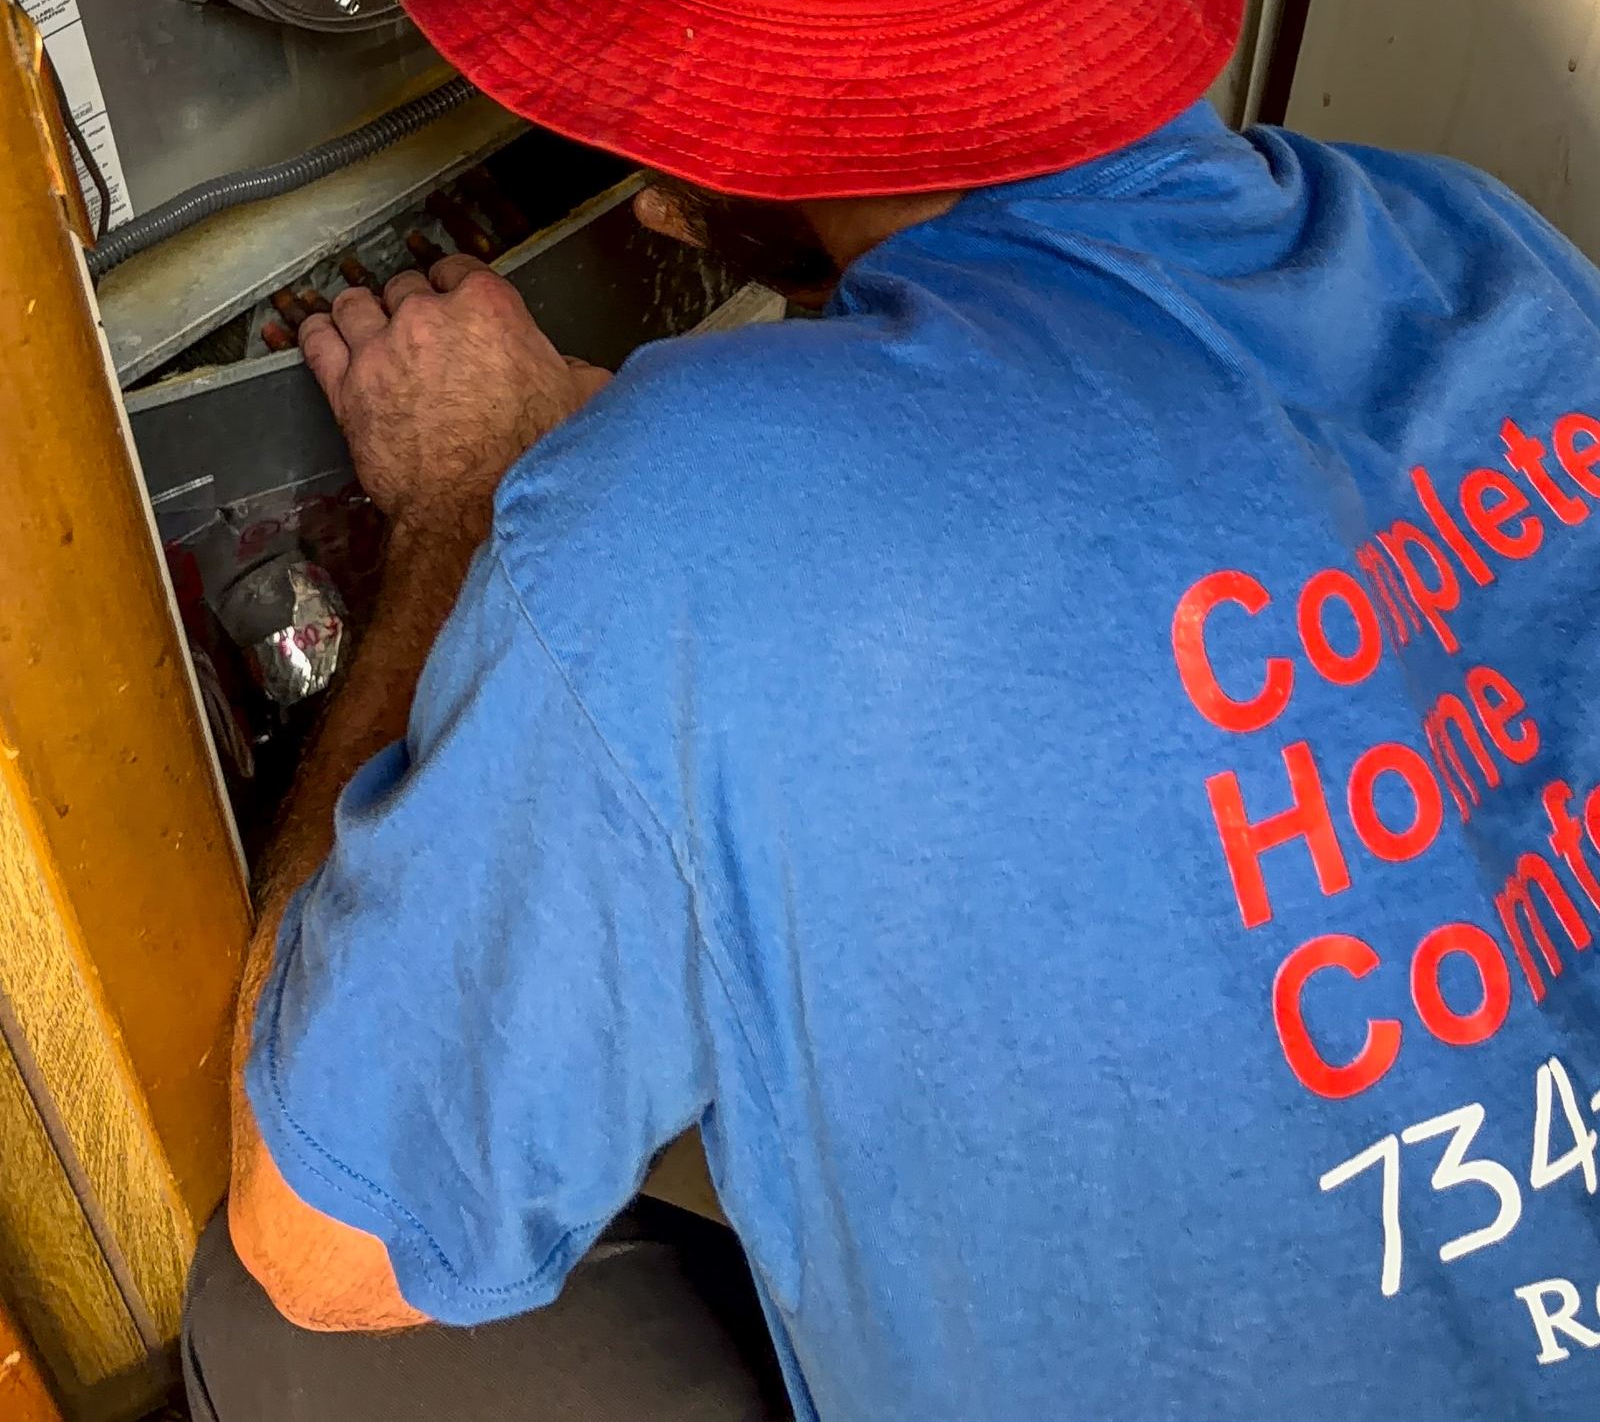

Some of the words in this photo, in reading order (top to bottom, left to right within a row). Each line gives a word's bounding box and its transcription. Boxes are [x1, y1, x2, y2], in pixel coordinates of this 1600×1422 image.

[1207, 667, 1539, 928] Home
[1274, 780, 1600, 1099] Comf
[1514, 1277, 1600, 1365] R
